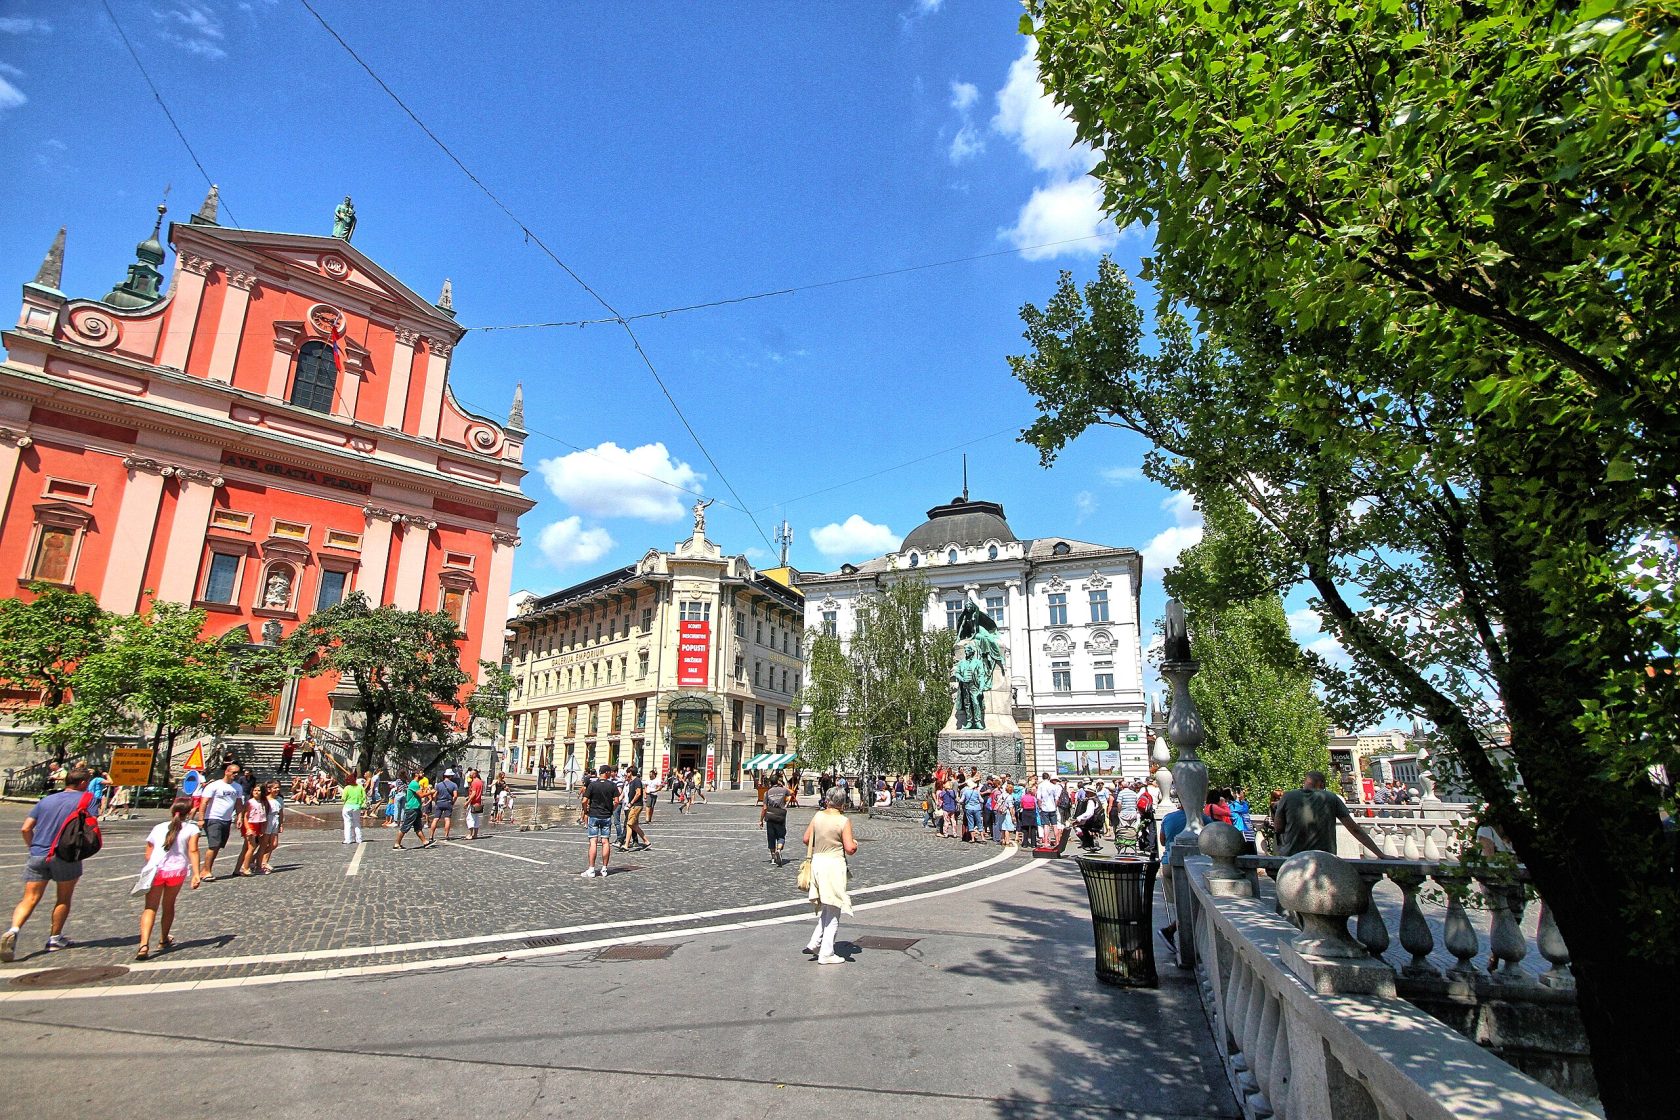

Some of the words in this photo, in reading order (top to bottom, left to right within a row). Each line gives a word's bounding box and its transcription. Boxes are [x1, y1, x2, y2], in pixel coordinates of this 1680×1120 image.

[226, 453, 258, 469] AVE
[264, 462, 318, 482] GRATIA
[575, 648, 604, 662] EMPORIUM
[681, 644, 705, 652] POPUSTI
